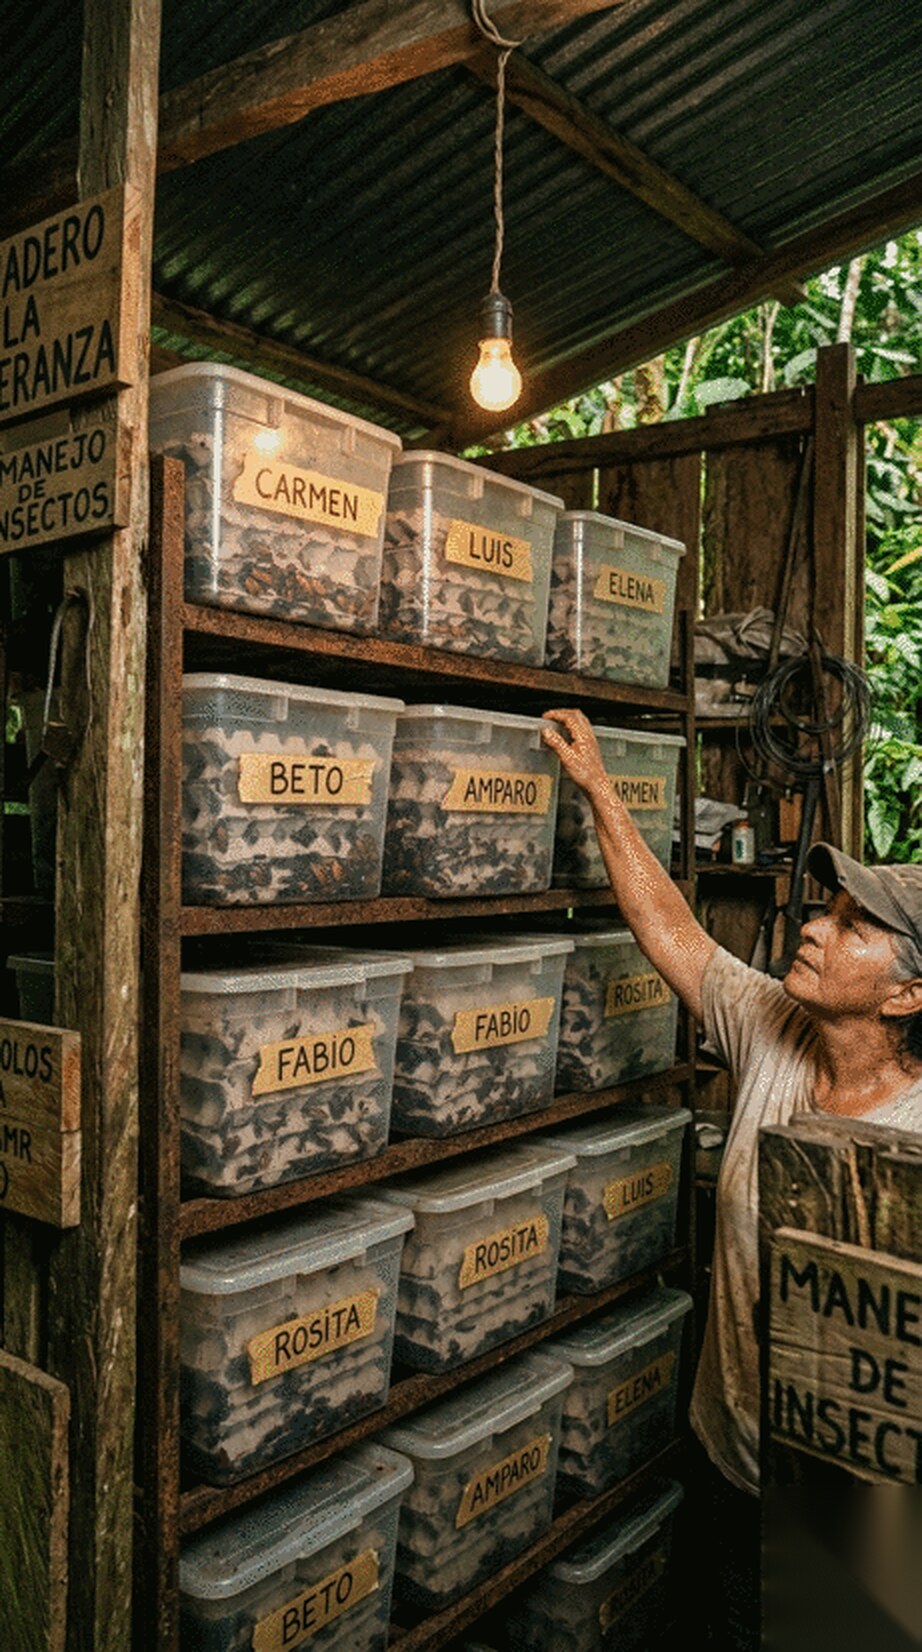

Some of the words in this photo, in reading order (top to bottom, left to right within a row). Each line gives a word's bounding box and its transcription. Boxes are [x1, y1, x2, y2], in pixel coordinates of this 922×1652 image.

[2, 203, 105, 298] ADERO
[4, 294, 40, 348] LA
[0, 429, 106, 486] MANEJO
[18, 479, 46, 504] DE
[255, 468, 359, 521] CARMEN
[469, 532, 513, 568] LUIS
[609, 572, 655, 604] ELENA
[270, 762, 343, 795] BETO
[464, 776, 537, 806] AMPARO
[0, 1038, 52, 1083] OLOS
[622, 1172, 653, 1206] LUIS
[780, 1253, 922, 1346] MANE
[615, 1366, 660, 1414] ELENA
[850, 1347, 909, 1408] DE
[774, 1379, 922, 1485] INSECT
[469, 1447, 541, 1512] AMPARO
[282, 1571, 353, 1645] BETO
